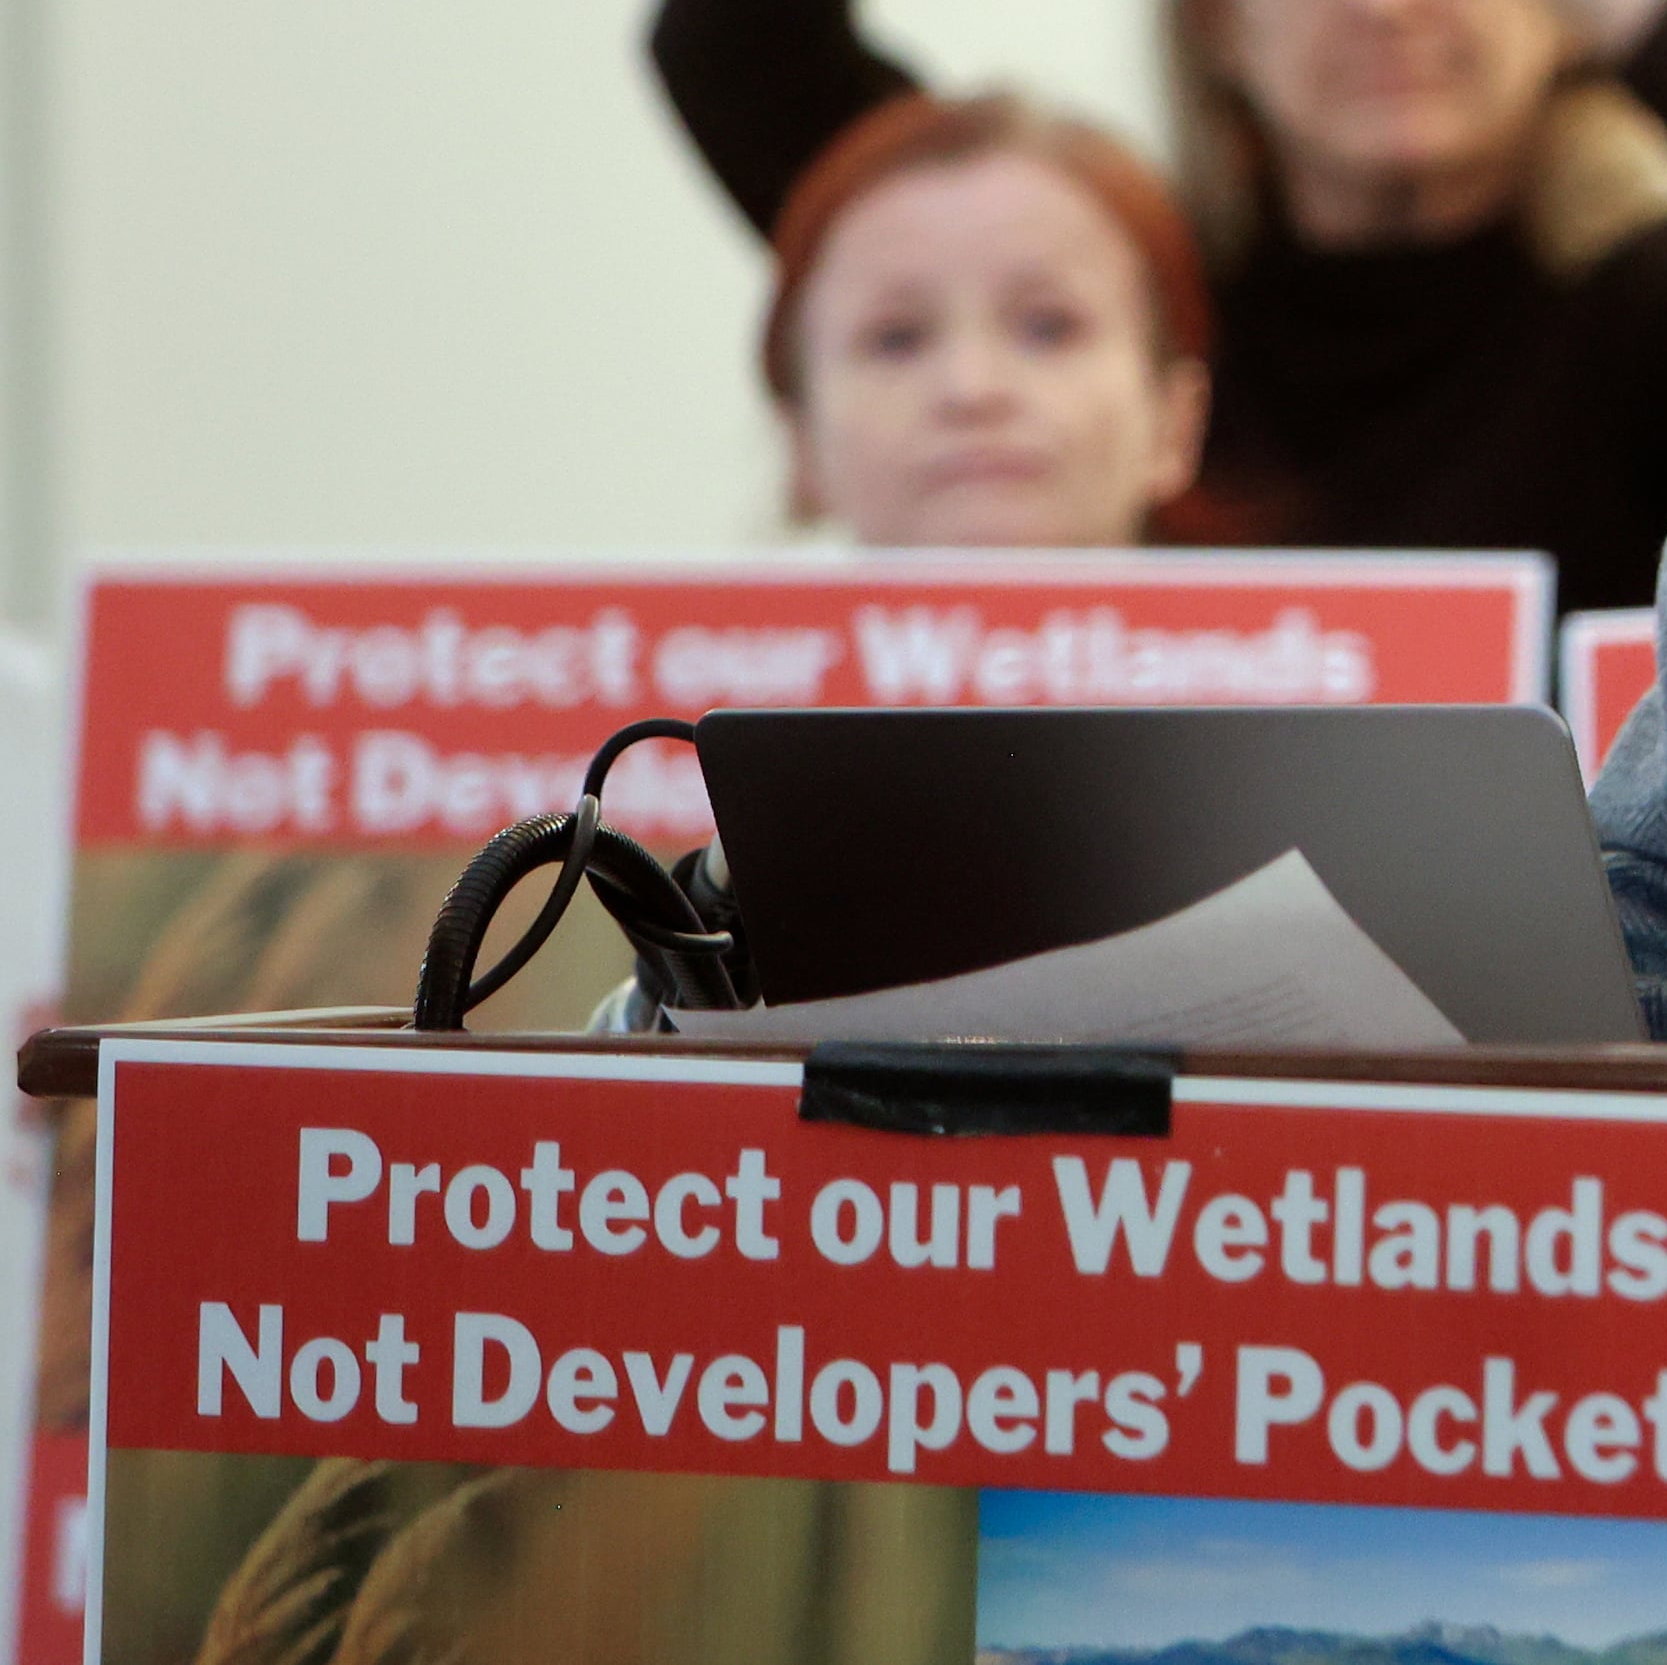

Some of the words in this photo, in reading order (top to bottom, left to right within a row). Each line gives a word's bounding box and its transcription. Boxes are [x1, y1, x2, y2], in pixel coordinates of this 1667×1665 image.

[225, 601, 636, 708] Protect
[653, 620, 840, 708] our
[852, 603, 1376, 705] Wetlands
[137, 731, 333, 831] Not
[298, 1127, 788, 1265] Protect
[808, 1183, 1020, 1270] our
[198, 1303, 420, 1427] Not
